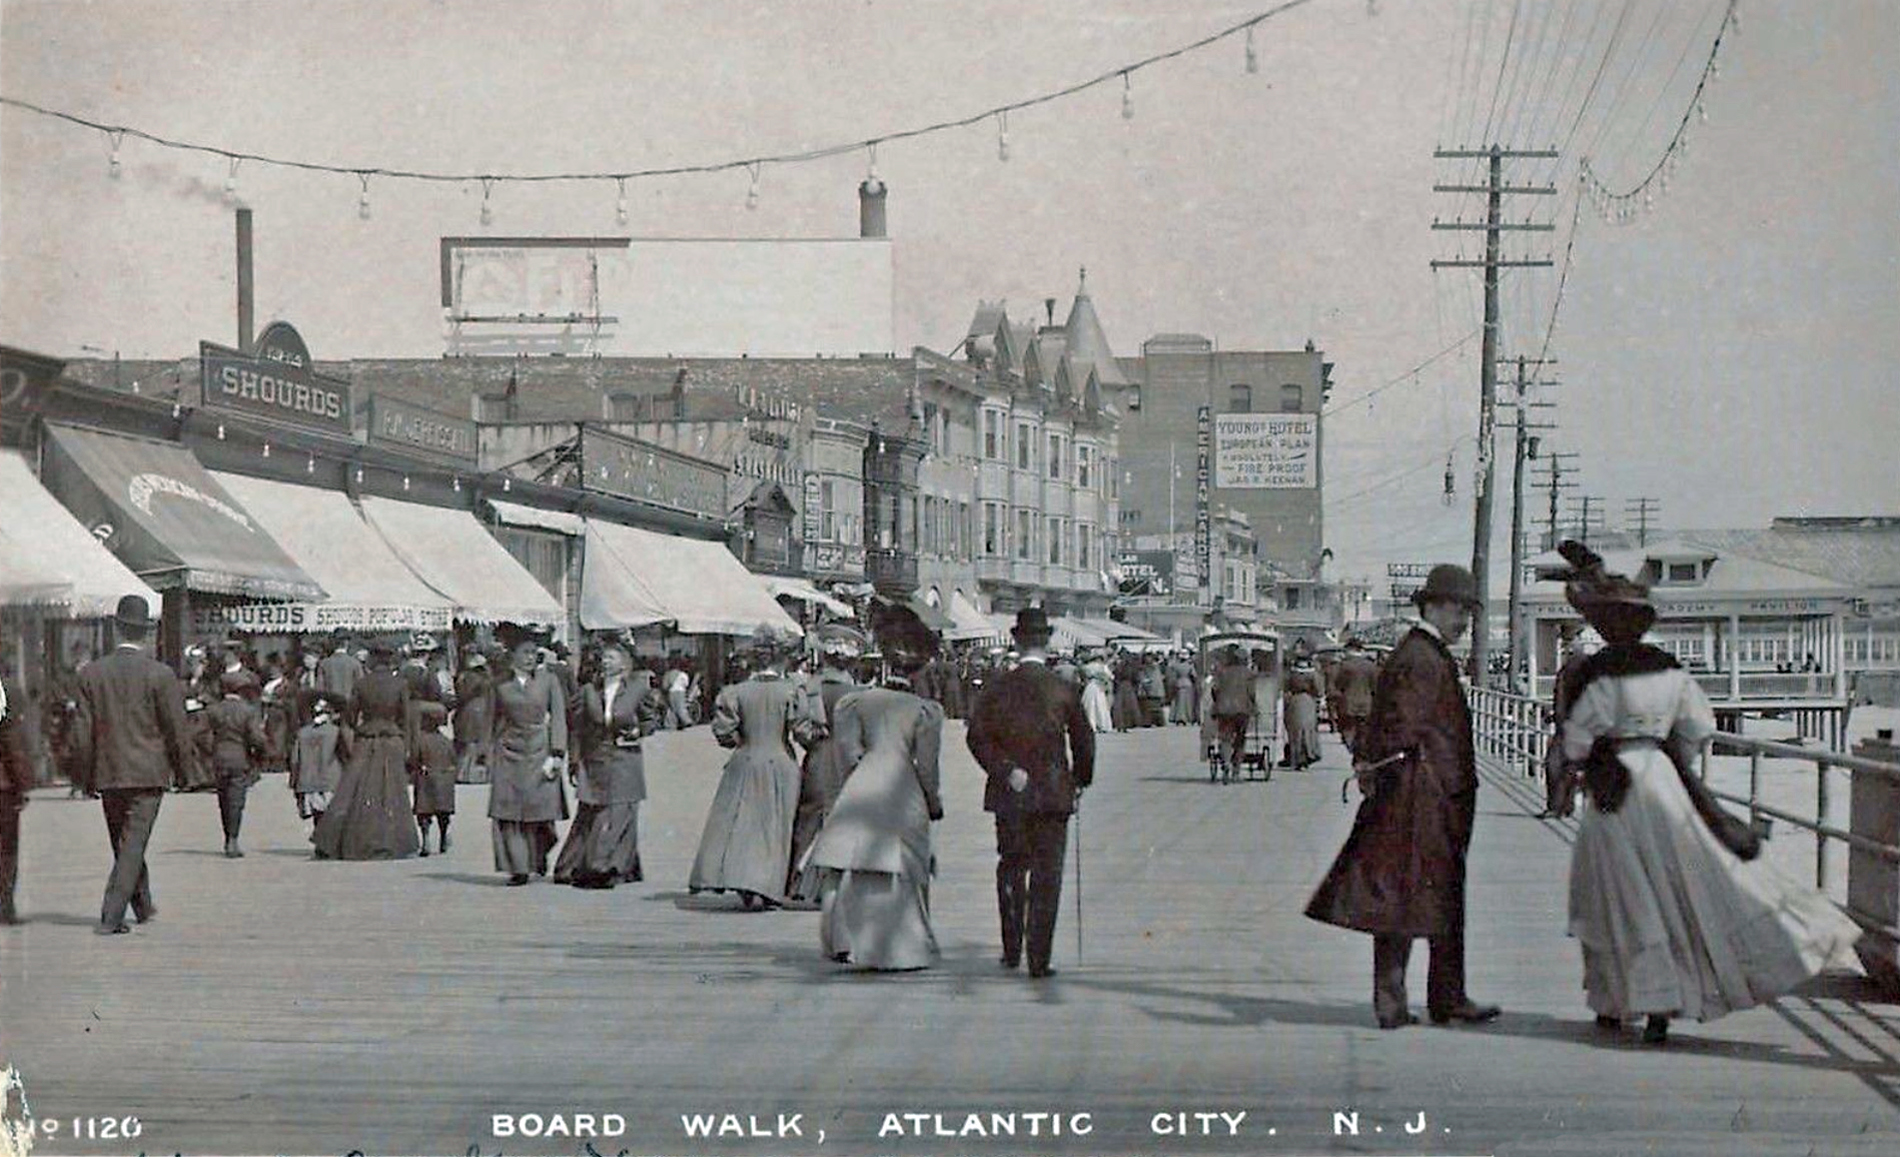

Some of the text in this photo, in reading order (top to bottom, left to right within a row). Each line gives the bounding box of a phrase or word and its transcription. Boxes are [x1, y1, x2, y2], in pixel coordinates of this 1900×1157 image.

[222, 366, 341, 420] SHOURDS
[1269, 421, 1312, 435] HOTEL
[1238, 463, 1306, 474] FIRE PROOF
[195, 606, 304, 625] SHOURDS
